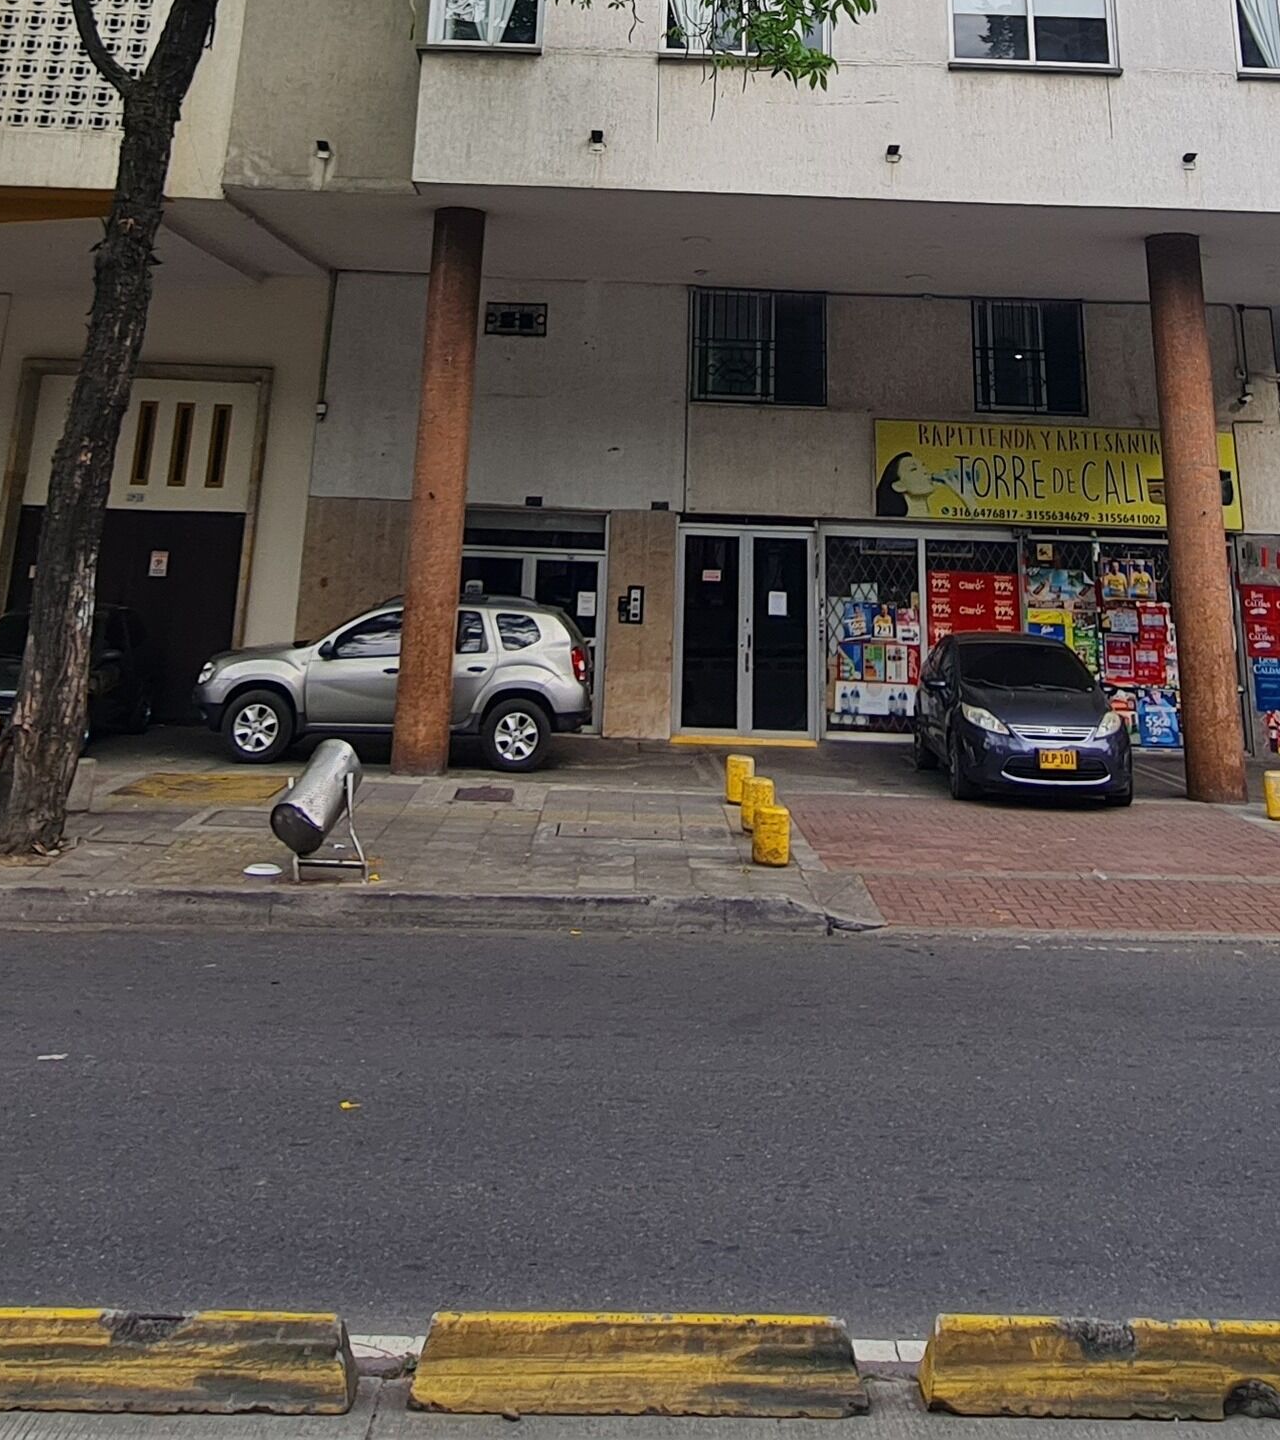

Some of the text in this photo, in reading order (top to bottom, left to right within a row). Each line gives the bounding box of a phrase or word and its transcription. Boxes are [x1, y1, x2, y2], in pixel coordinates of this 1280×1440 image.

[919, 422, 1037, 451] RAPITIENDA
[1040, 430, 1051, 452] Y
[954, 454, 1145, 505] TORRE DE CALI
[951, 507, 971, 517] 316
[931, 579, 951, 589] 99%
[959, 579, 983, 590] Claro
[994, 581, 1013, 591] 99%
[931, 603, 951, 613] 99%
[959, 603, 983, 615] Claro
[994, 606, 1014, 616] 99%
